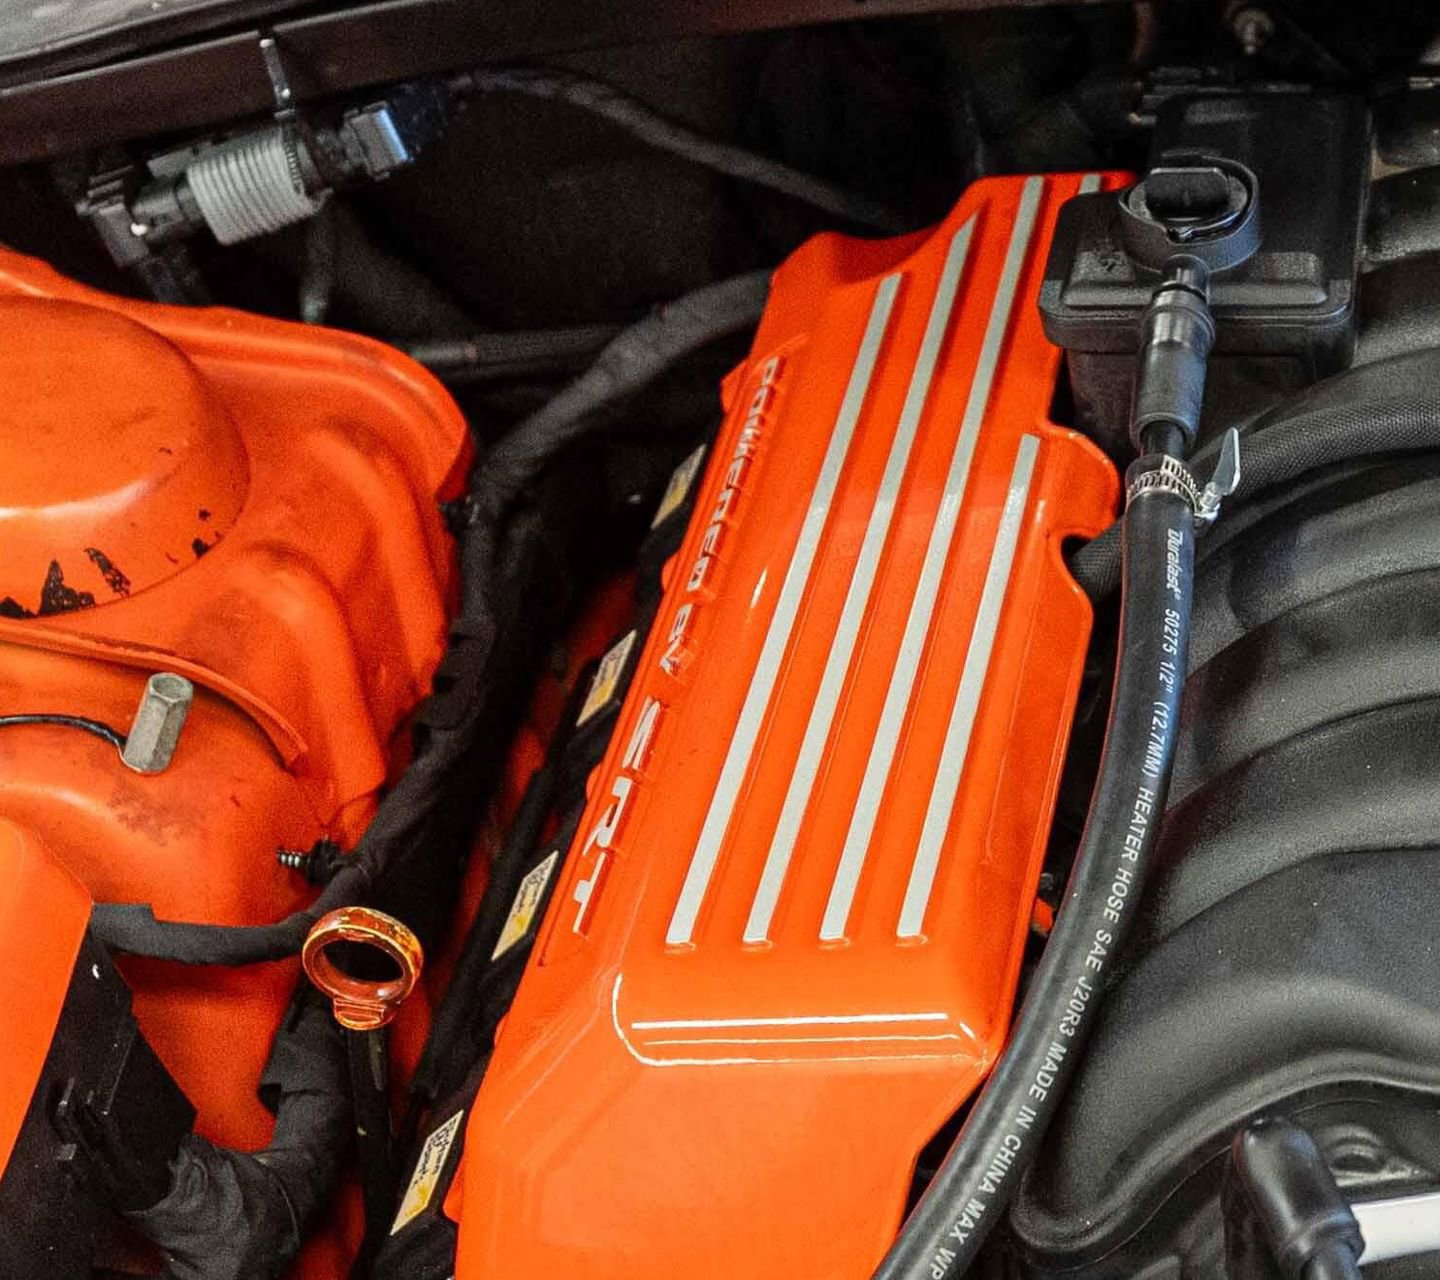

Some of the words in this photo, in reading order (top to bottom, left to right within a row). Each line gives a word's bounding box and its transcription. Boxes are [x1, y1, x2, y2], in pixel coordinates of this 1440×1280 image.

[688, 355, 780, 592] POWERED
[1162, 607, 1180, 656] 50275
[1141, 701, 1170, 779] (12.7MM)
[572, 695, 660, 933] SRT
[1120, 786, 1154, 864] HEATER
[1103, 867, 1133, 924] HOSE
[1085, 928, 1112, 972] SAE
[1059, 977, 1094, 1037] J20R3
[1028, 1039, 1068, 1102] MADE
[1011, 1103, 1038, 1133] IN
[977, 1133, 1022, 1198] CHINA
[948, 1199, 987, 1246] MAX
